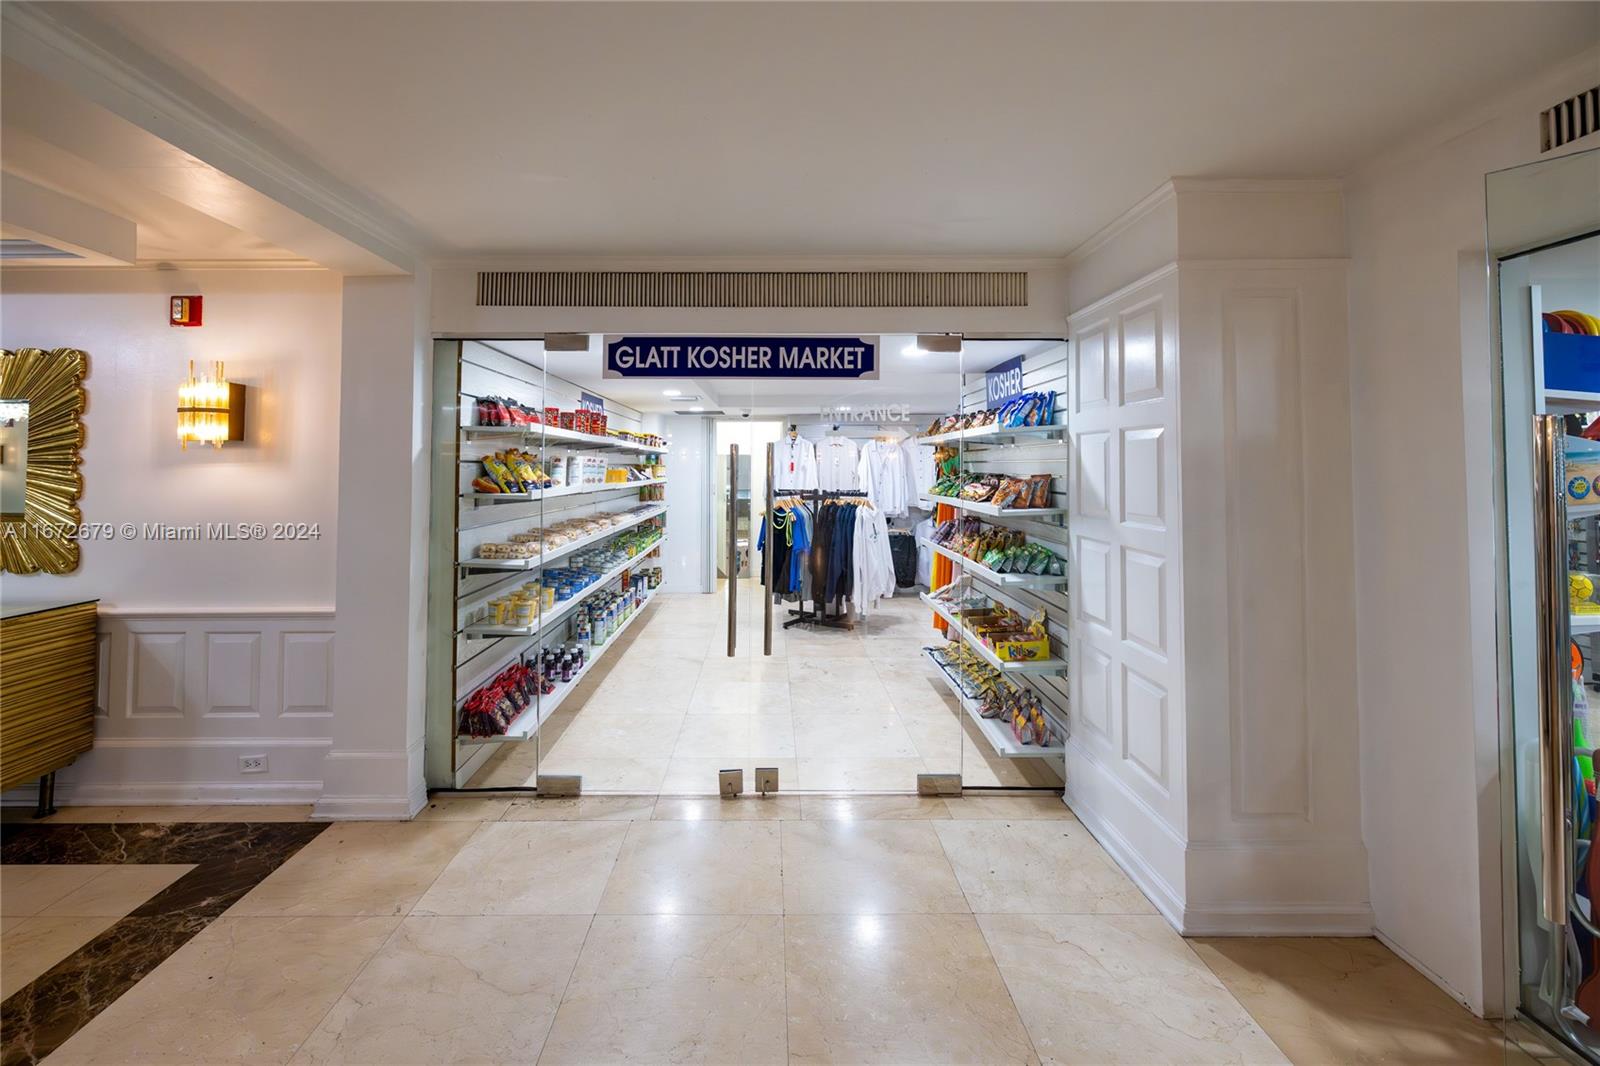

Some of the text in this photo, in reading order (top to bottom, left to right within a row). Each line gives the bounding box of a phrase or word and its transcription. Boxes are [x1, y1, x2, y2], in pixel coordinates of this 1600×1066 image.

[615, 346, 864, 369] GLATT KOSHER MARKET
[988, 367, 1021, 402] KOSHER
[820, 404, 910, 422] ENTRANCE
